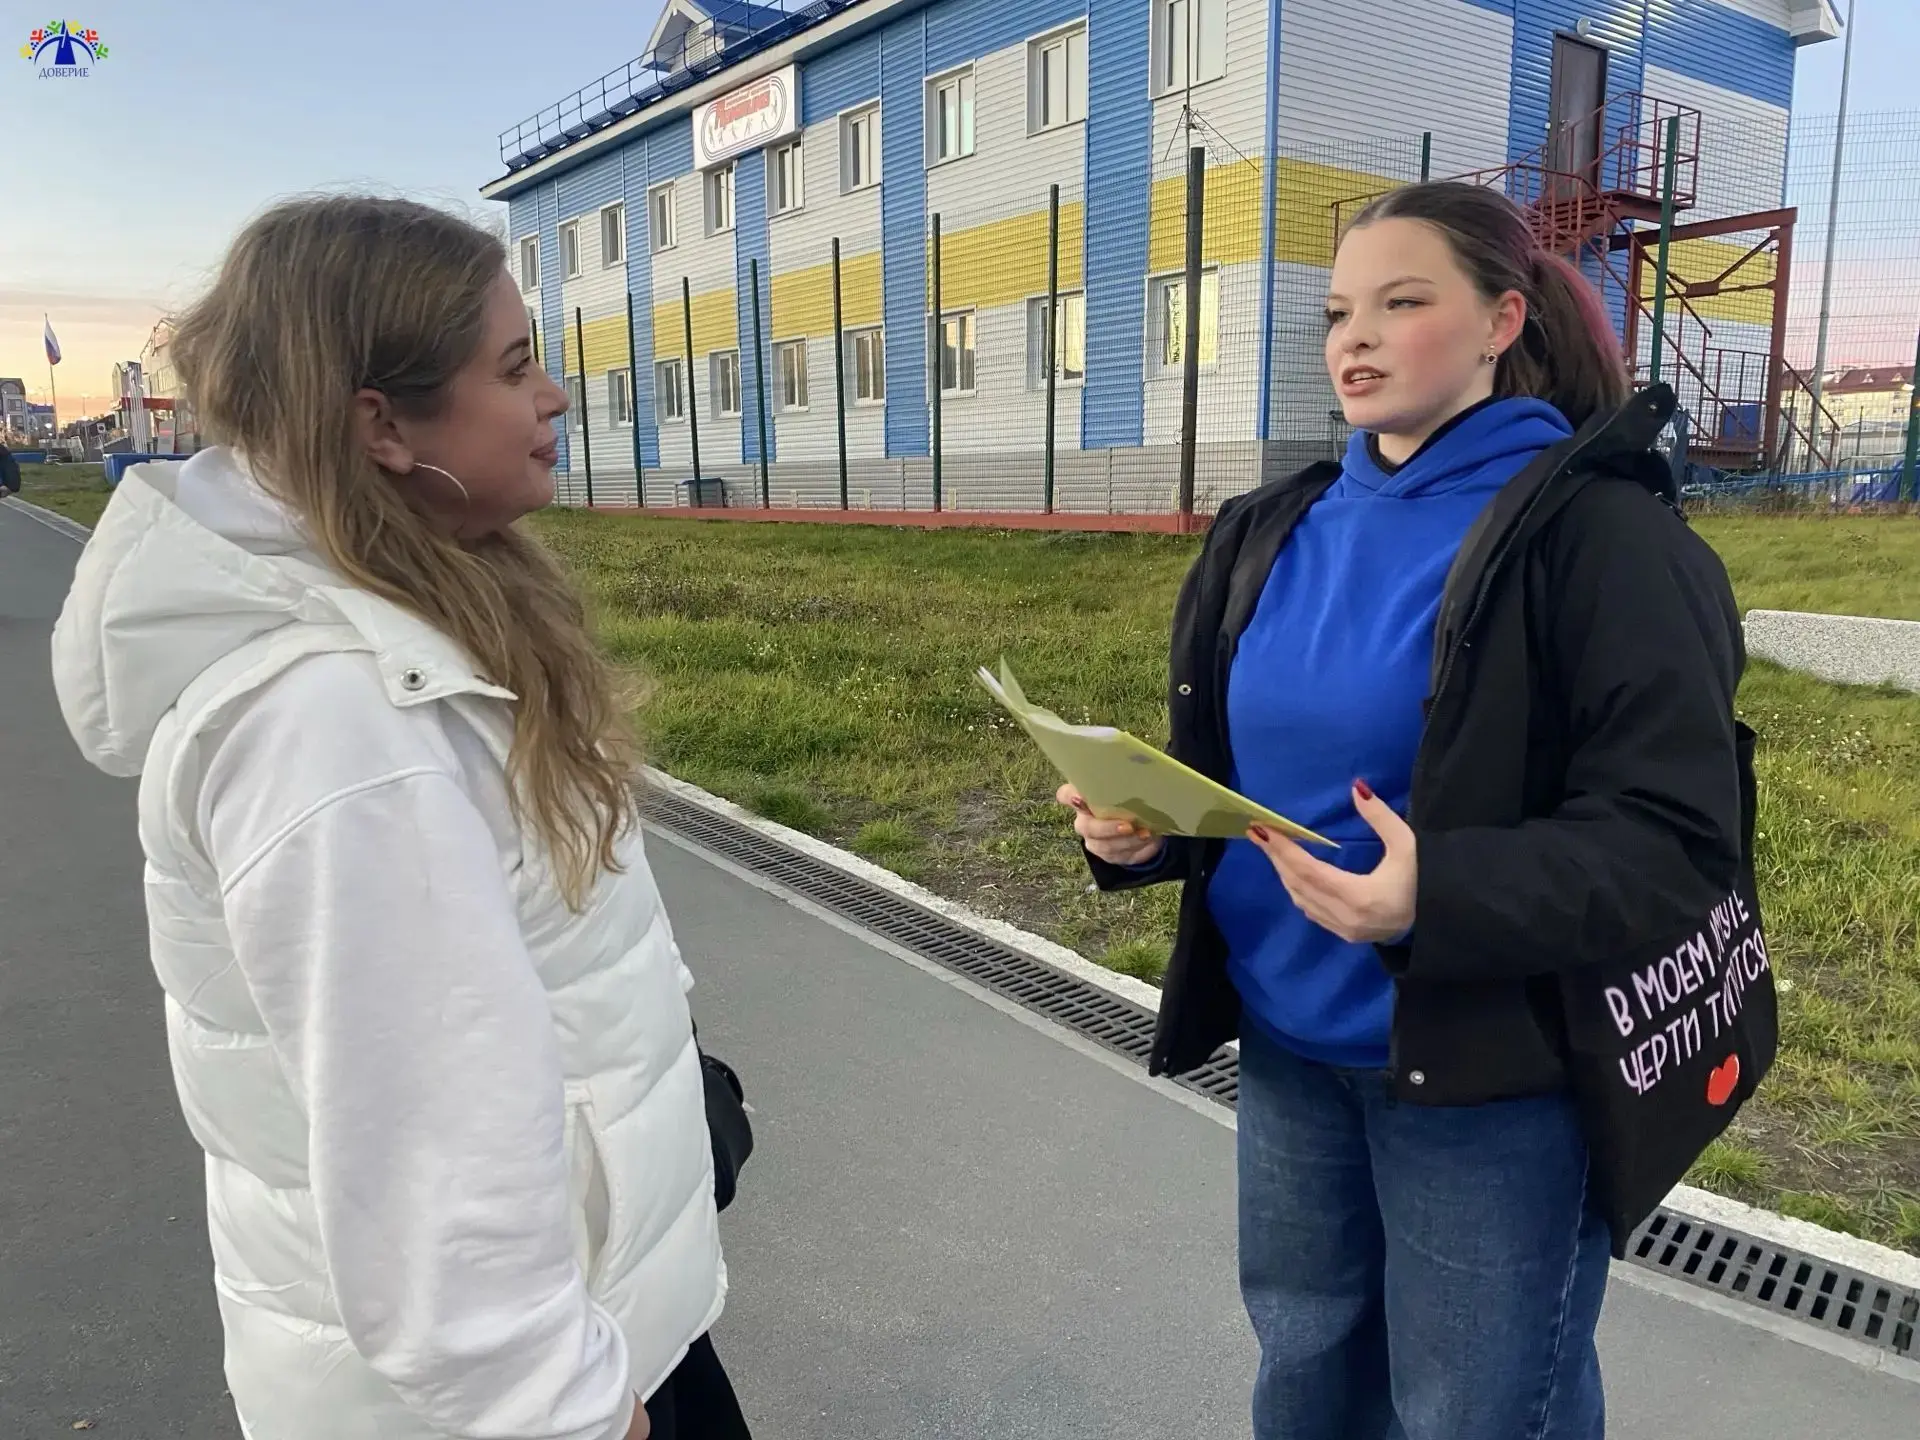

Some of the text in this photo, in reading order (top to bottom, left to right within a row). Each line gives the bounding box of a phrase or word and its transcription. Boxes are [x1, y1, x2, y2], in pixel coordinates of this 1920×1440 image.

[1604, 986, 1634, 1037] В
[1631, 931, 1716, 1020] МОЕМ
[1619, 1007, 1701, 1096] ЧЕРТИ
